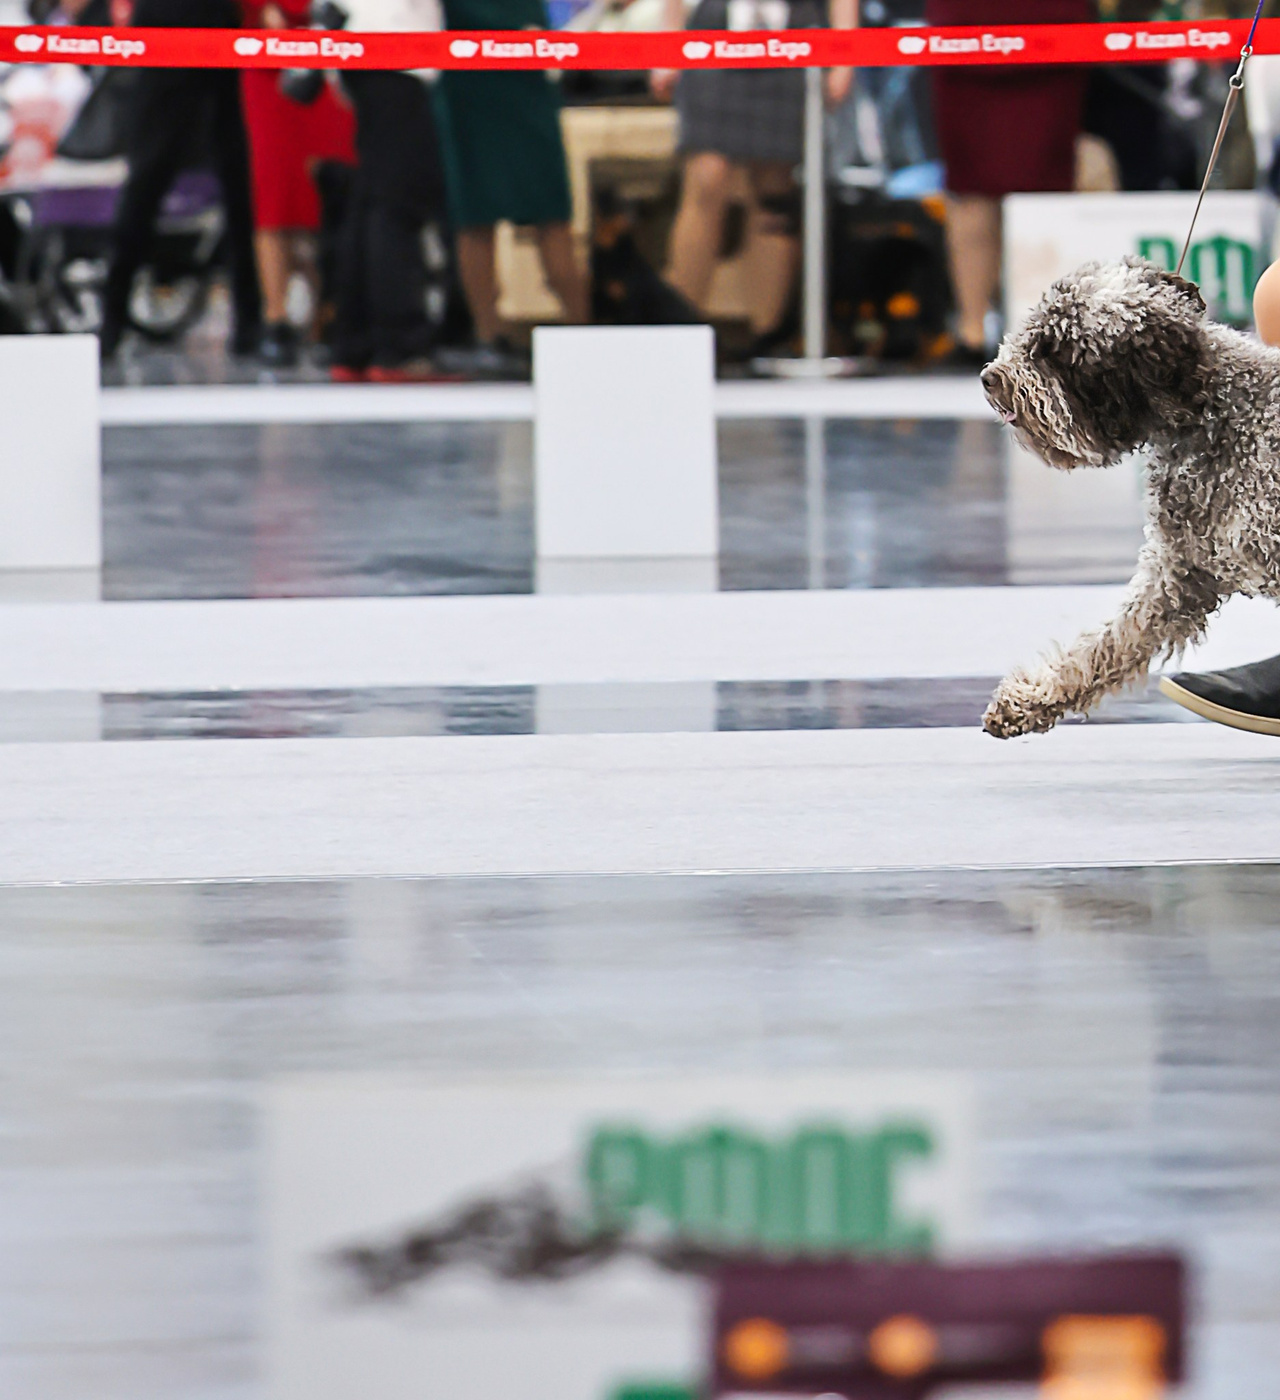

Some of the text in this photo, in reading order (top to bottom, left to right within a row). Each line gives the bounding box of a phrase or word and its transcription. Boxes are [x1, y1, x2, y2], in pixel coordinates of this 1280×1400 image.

[47, 35, 146, 58] Kazan Expo
[266, 38, 364, 60] Kazan Expo
[929, 33, 1025, 55] Kazan Expo
[1136, 28, 1231, 49] Kazan Expo
[482, 39, 579, 61] Kazan Expo
[714, 39, 811, 61] Kazan Expo
